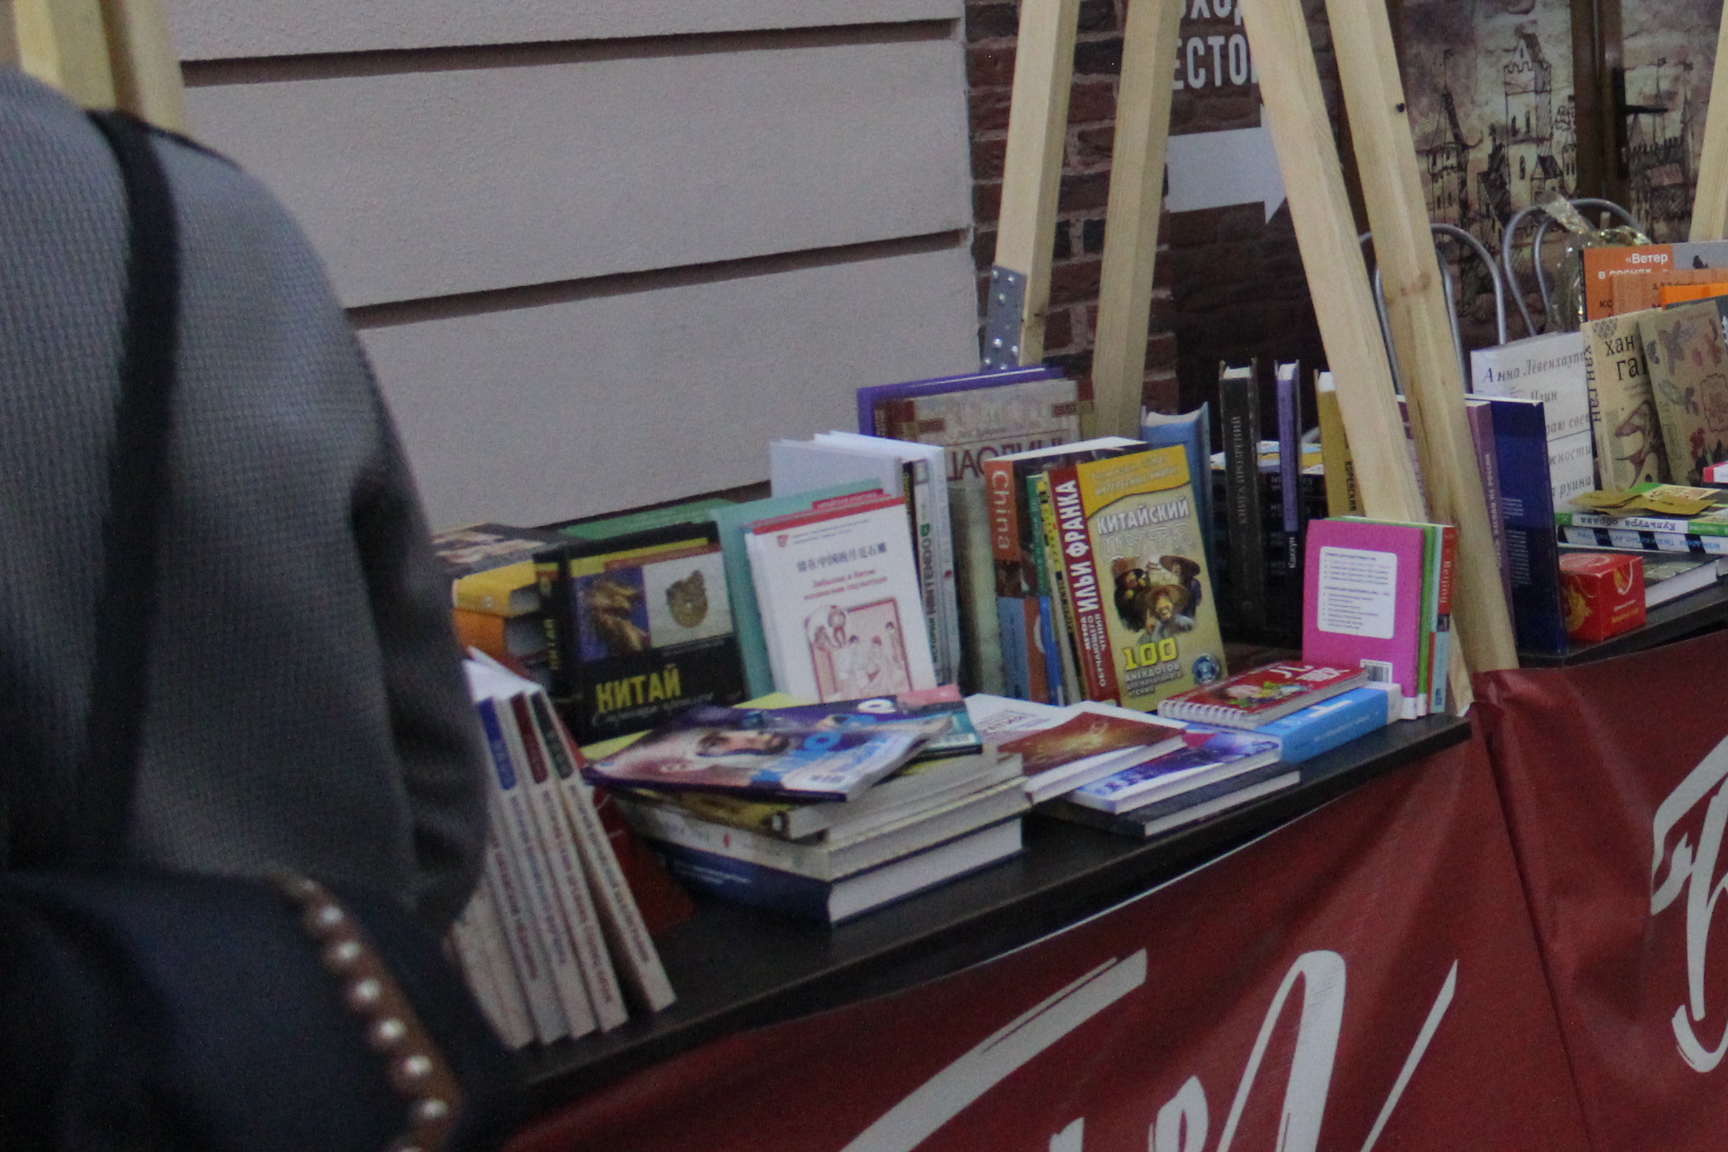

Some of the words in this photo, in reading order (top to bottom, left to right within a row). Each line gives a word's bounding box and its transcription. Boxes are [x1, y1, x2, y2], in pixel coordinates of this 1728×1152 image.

[1482, 367, 1521, 384] Анна
[992, 470, 1011, 550] China
[1056, 479, 1091, 558] ФРАНКА
[1096, 496, 1190, 535] КИТАЙСКИЙ
[1071, 560, 1099, 613] ИЛЬИ
[1123, 637, 1179, 671] 100
[595, 663, 682, 714] КИТАЙ
